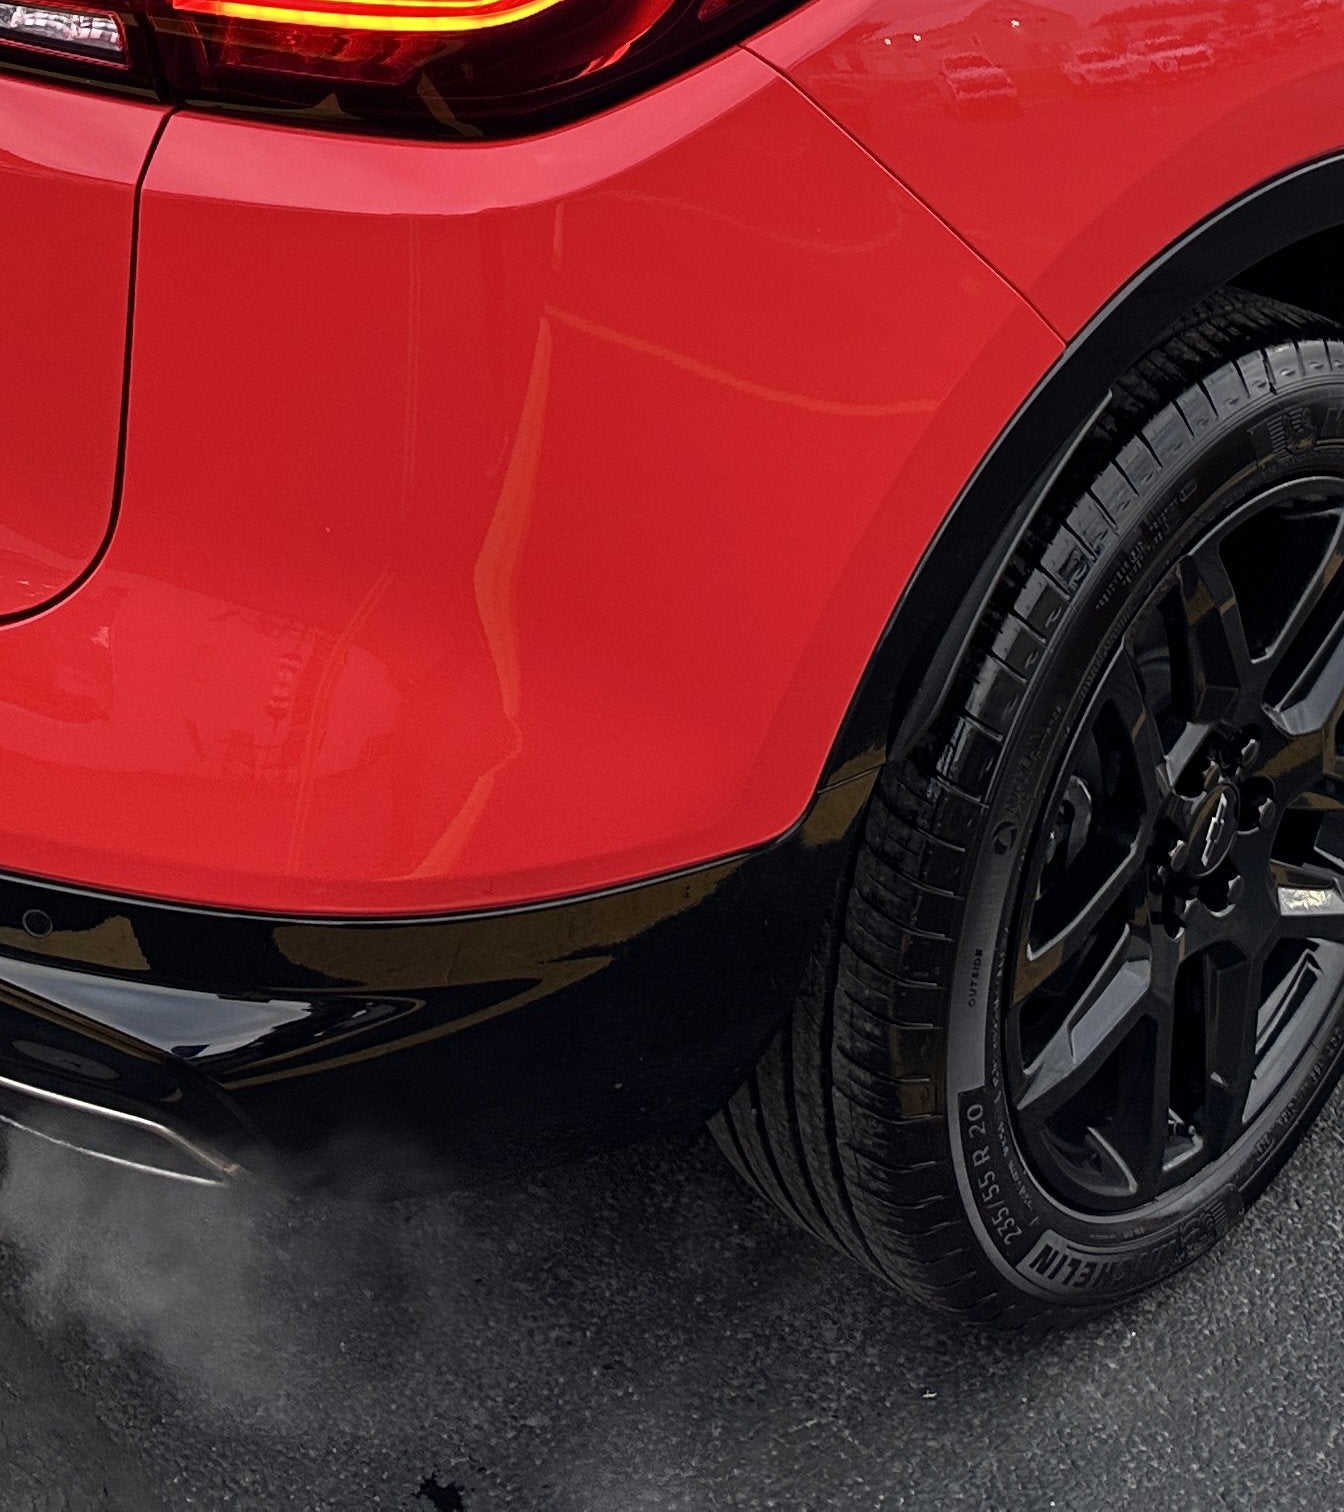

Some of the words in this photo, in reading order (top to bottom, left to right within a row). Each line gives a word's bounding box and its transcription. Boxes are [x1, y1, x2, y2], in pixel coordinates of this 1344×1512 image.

[967, 948, 984, 1008] OUTSIDE
[966, 1102, 988, 1140] 20
[972, 1144, 992, 1169] R
[977, 1170, 1023, 1246] 235/55
